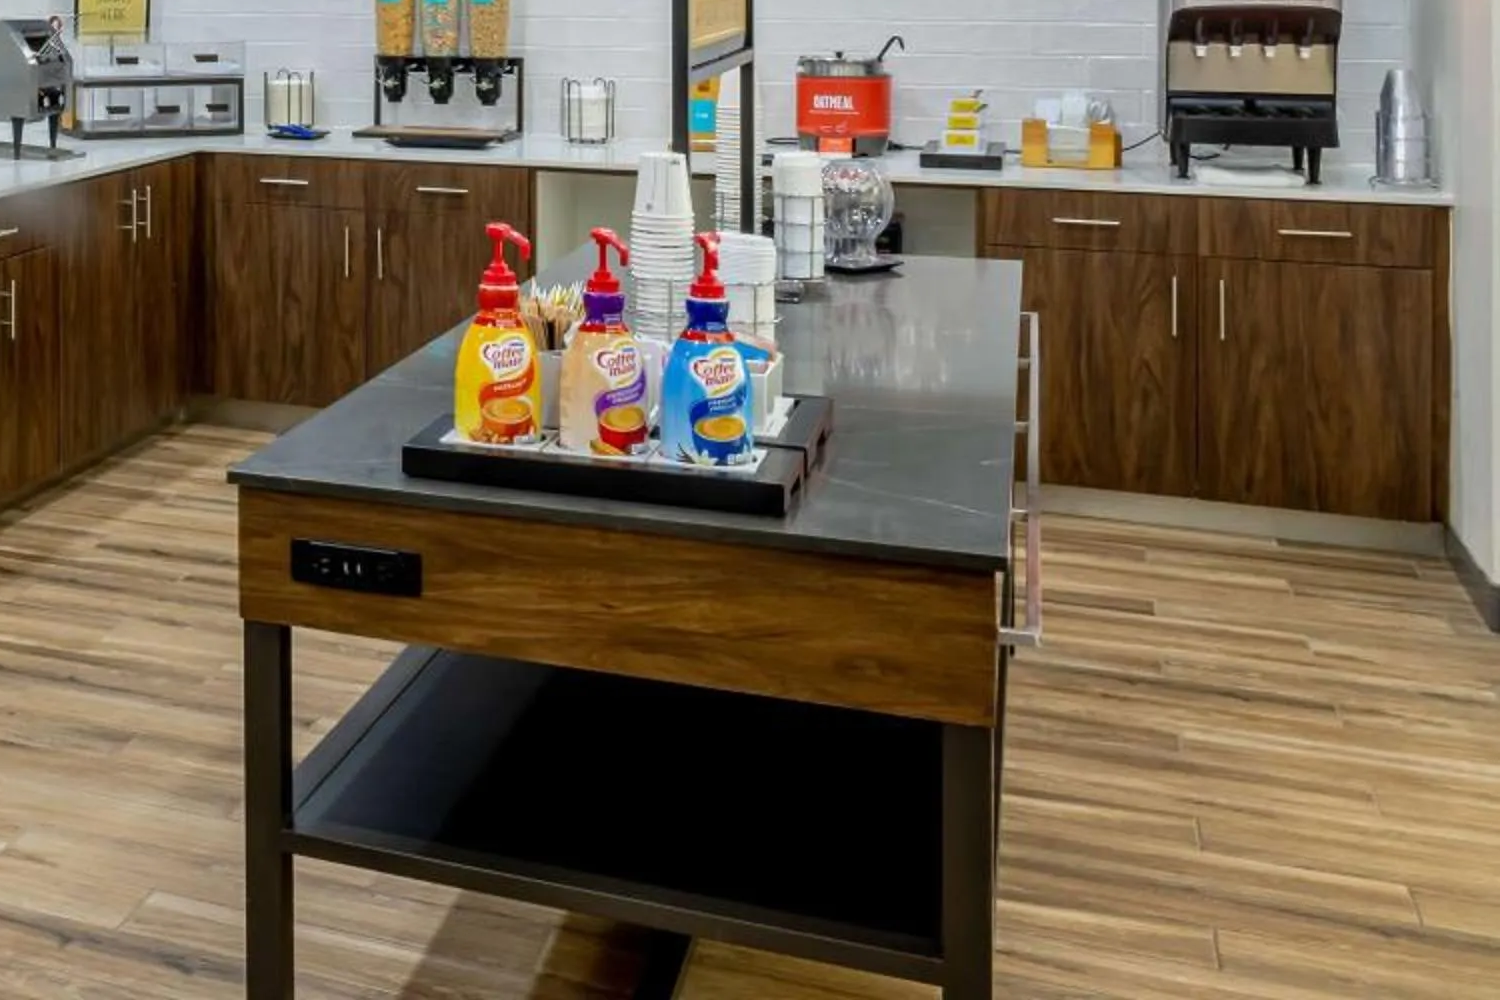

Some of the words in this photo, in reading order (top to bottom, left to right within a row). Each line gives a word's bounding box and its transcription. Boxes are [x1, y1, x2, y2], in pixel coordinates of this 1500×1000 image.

[813, 94, 854, 110] OATMEAL
[483, 343, 521, 362] Coffee
[597, 350, 636, 368] Coffee
[693, 359, 733, 378] Coffee
